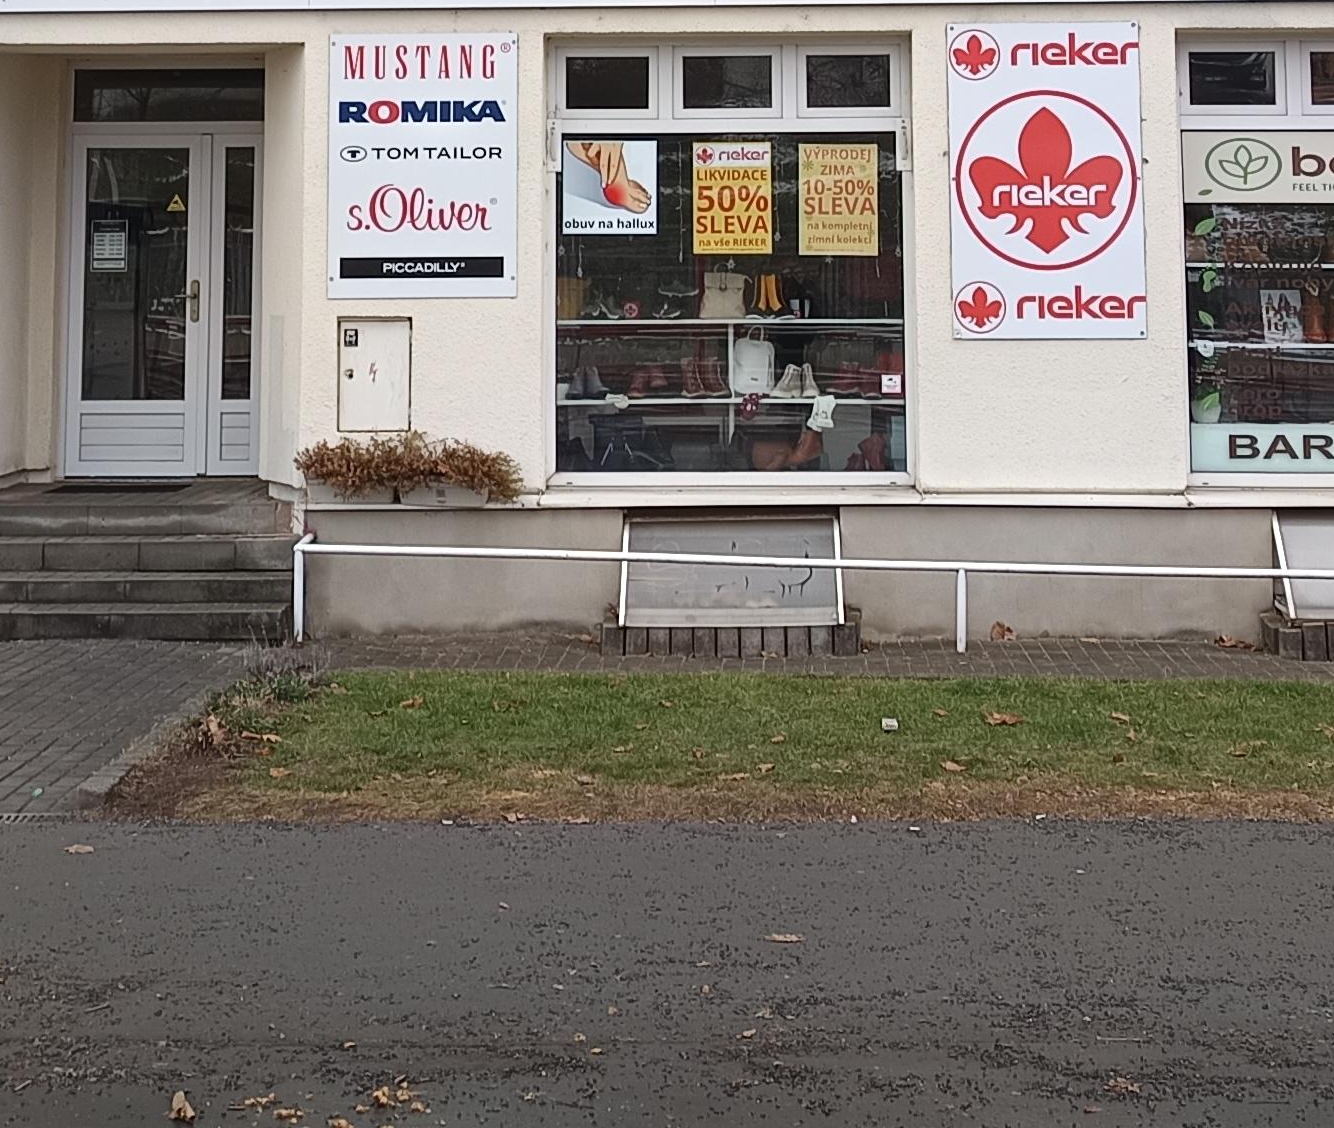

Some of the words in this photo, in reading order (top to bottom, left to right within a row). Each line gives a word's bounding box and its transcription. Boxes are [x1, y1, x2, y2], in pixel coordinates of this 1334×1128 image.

[1010, 32, 1139, 66] rieker
[343, 44, 495, 80] MUSTANG
[338, 100, 506, 124] ROMIKA
[371, 147, 419, 160] TOM
[423, 146, 502, 160] TAILOR
[718, 147, 769, 161] rieker
[803, 147, 872, 163] VÝPRODEJ
[696, 169, 767, 181] LIKVIDACE
[820, 164, 855, 176] ZIMA
[804, 179, 874, 196] 10-50%
[992, 175, 1107, 207] rieker
[1292, 183, 1318, 191] FEEL
[696, 185, 768, 213] 50%
[804, 197, 876, 216] SLEVA
[346, 183, 493, 233] s.Oliver
[564, 218, 595, 229] obuv
[598, 221, 613, 229] na
[617, 218, 654, 229] hallux
[696, 215, 768, 234] SLEVA
[822, 220, 873, 232] kompletní
[698, 239, 711, 247] na
[714, 238, 730, 247] vše
[732, 238, 767, 247] RIEKER
[382, 262, 461, 273] PICCADILLY
[1017, 285, 1146, 319] rieker
